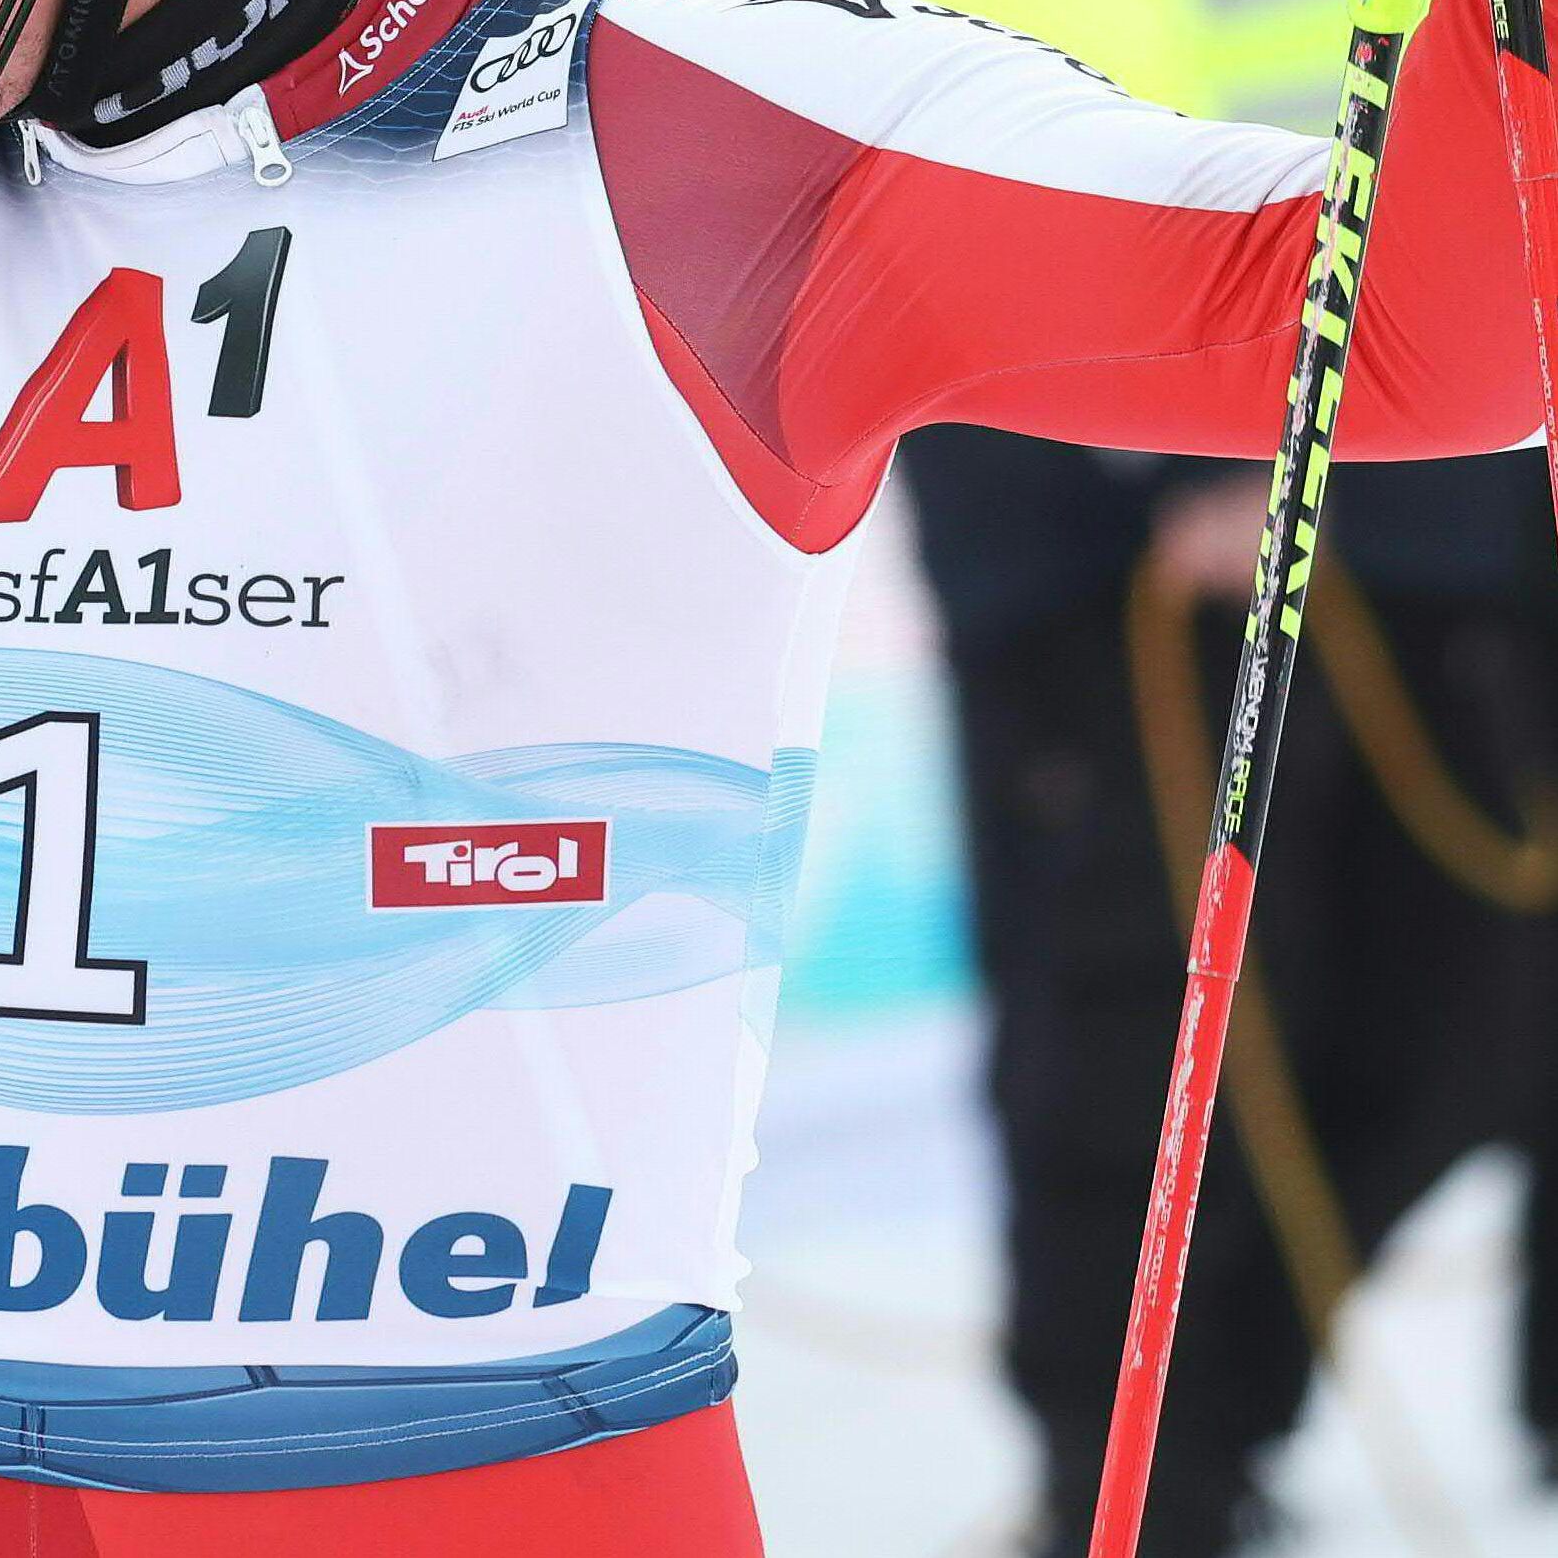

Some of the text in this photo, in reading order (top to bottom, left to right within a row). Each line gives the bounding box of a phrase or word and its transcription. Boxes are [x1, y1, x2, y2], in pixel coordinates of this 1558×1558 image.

[451, 87, 562, 135] FIS Ski World Cup
[456, 104, 489, 123] Audi
[1300, 61, 1390, 350] LEKI
[1224, 758, 1253, 834] RACE
[404, 837, 579, 892] Tirol
